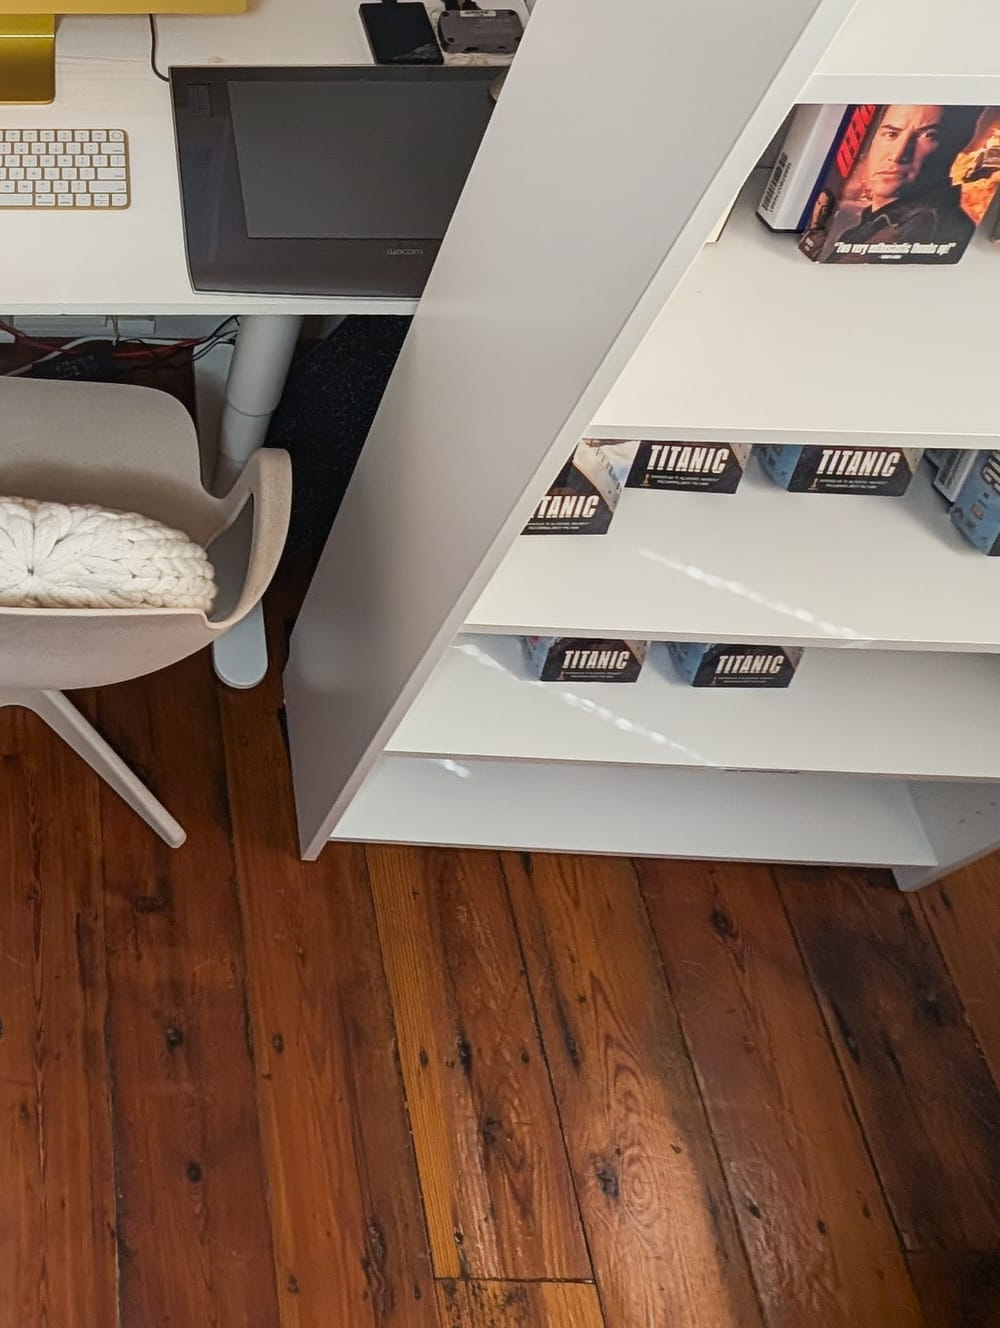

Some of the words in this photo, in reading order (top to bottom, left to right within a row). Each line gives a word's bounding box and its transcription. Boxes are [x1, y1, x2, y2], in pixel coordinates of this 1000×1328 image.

[647, 445, 730, 474] TITANIC
[816, 449, 901, 477] TITANIC
[533, 494, 600, 519] TANIC
[562, 650, 631, 670] TITANIC
[715, 655, 785, 674] TITANIC
